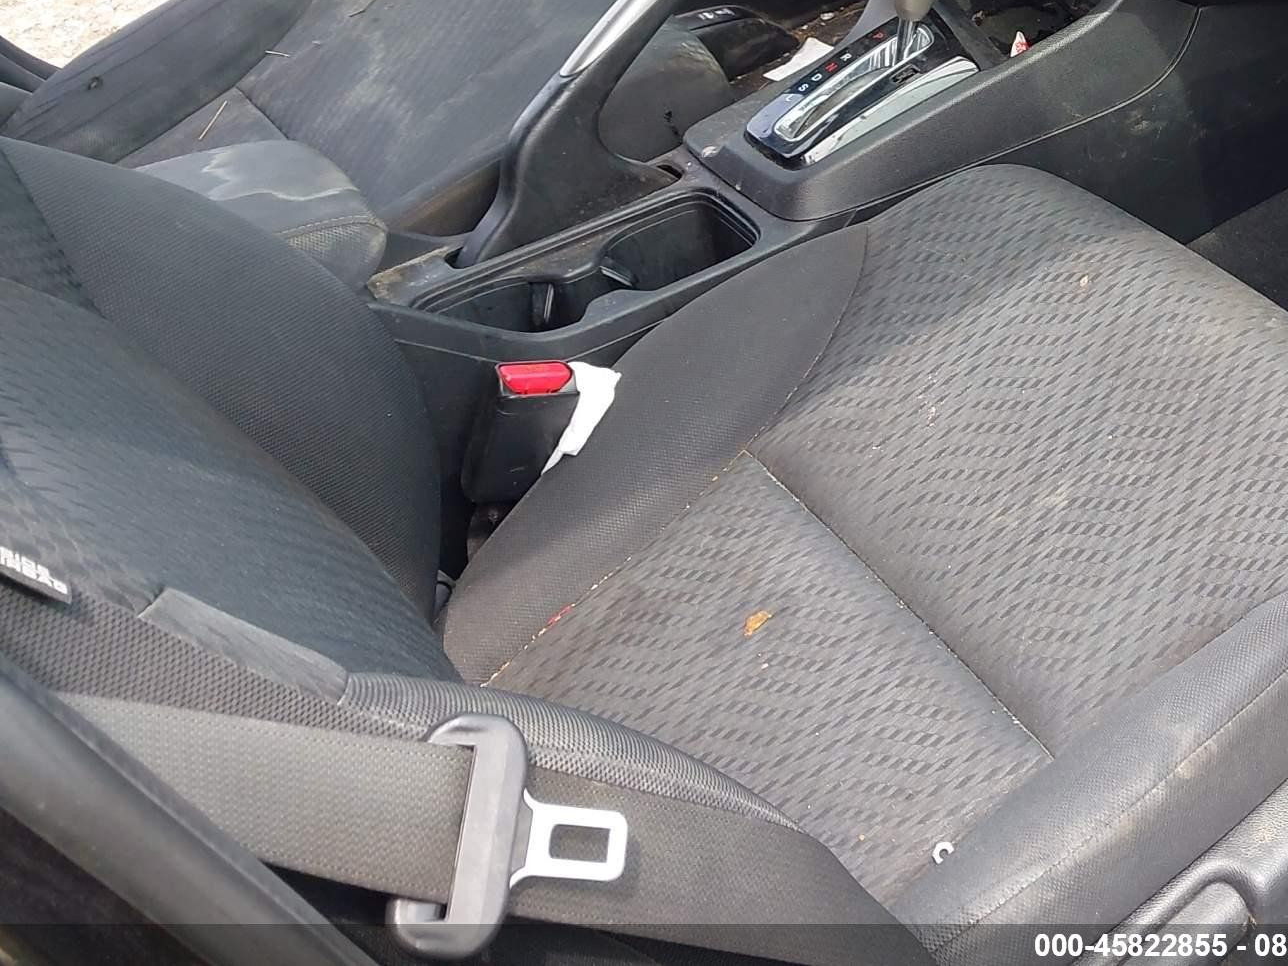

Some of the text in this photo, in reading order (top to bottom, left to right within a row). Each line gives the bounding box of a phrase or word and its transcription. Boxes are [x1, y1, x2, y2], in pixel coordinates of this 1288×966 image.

[873, 30, 884, 39] P
[840, 53, 852, 62] R
[811, 73, 823, 82] D
[797, 83, 809, 92] S
